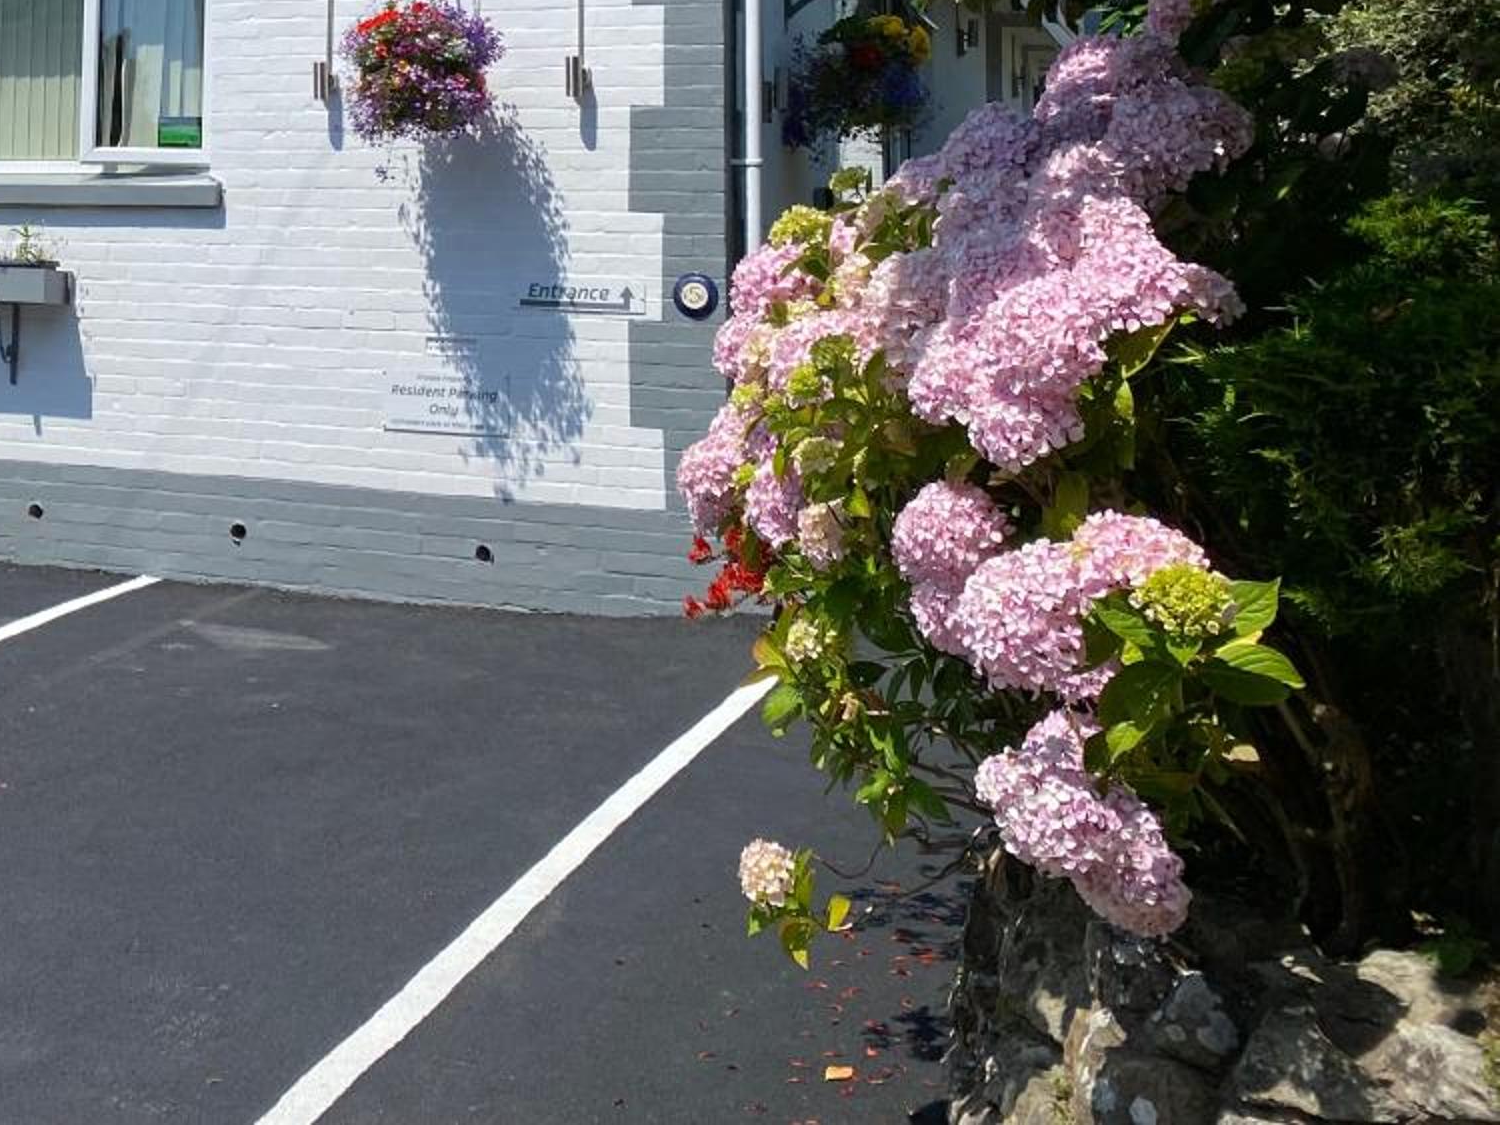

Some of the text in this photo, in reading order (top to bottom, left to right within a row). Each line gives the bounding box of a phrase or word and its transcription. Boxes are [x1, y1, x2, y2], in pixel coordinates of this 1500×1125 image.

[528, 283, 610, 301] Entrance
[391, 384, 445, 398] Resident
[429, 403, 459, 416] Only
